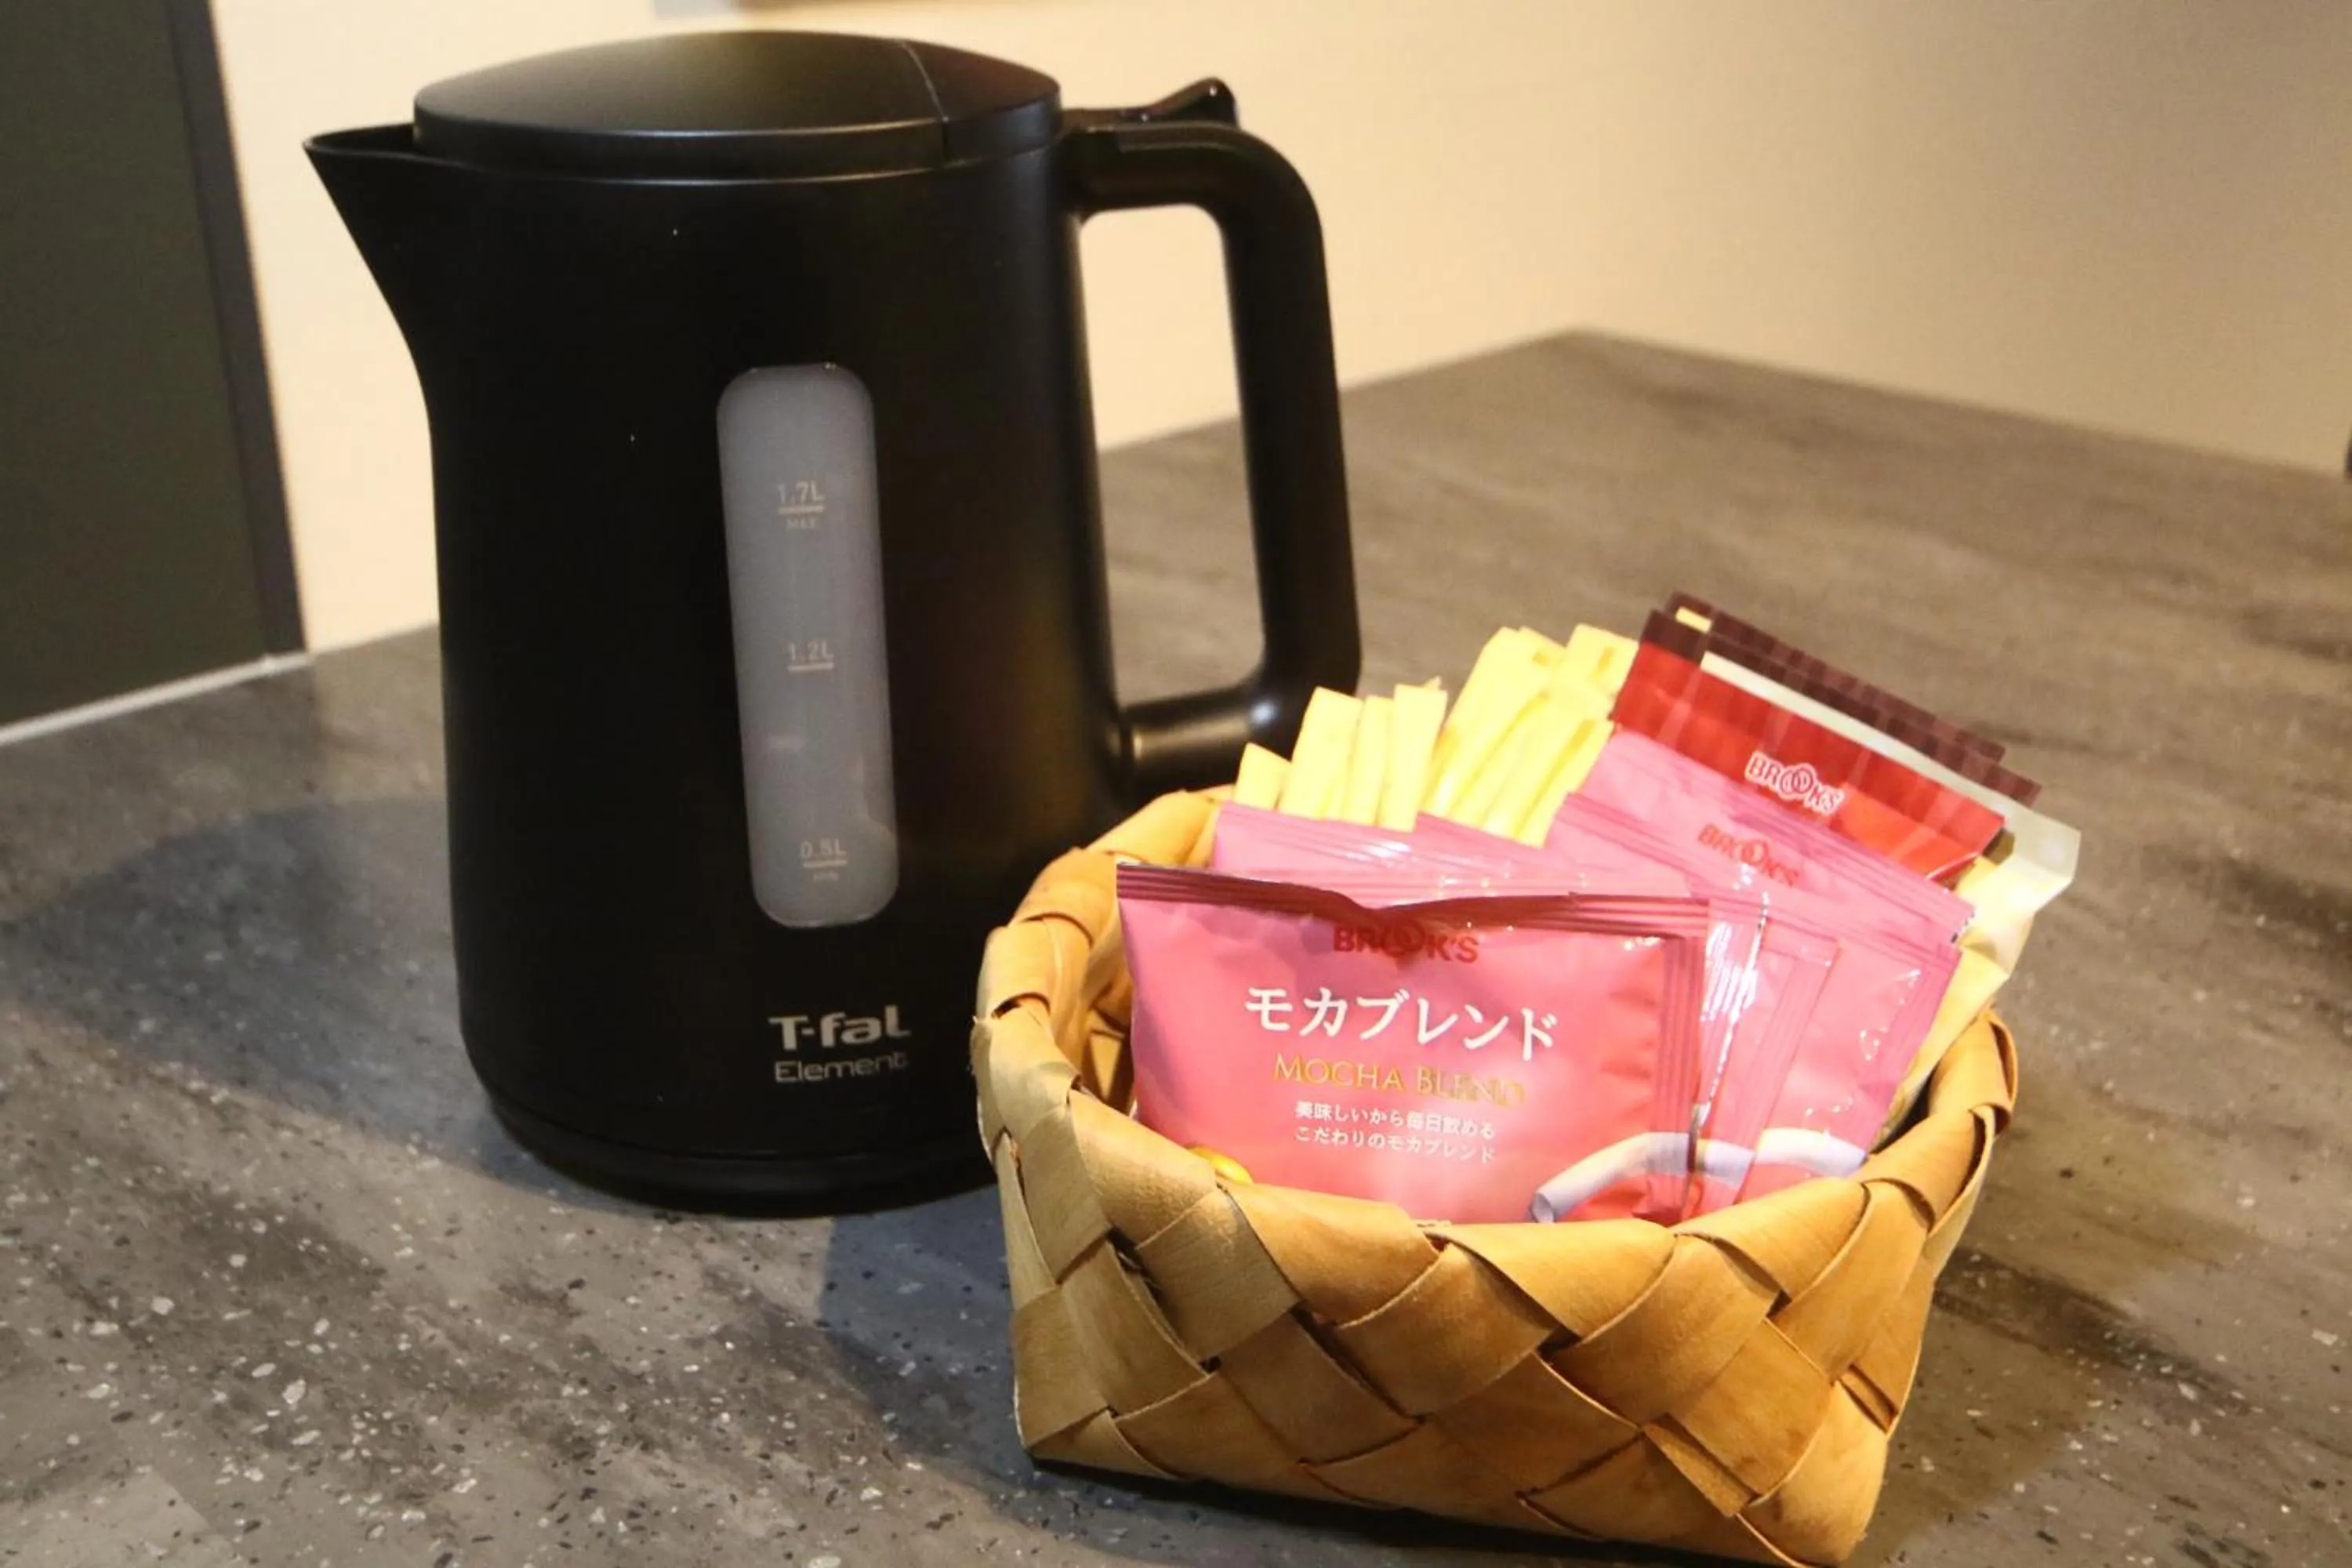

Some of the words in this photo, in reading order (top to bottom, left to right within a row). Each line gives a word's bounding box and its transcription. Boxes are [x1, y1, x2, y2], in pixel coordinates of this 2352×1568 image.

[777, 480, 825, 504] 1.7L
[788, 640, 834, 662] 1.2L
[768, 1004, 912, 1051] T-fal
[1244, 986, 1558, 1062] モカブレンド
[774, 1051, 908, 1083] Element
[1273, 1052, 1405, 1091] MOCHA
[1417, 1064, 1526, 1105] BLEND
[1294, 1101, 1496, 1140] 美味しいから毎日飲める
[1294, 1126, 1495, 1164] こだわりのモカブレンド
